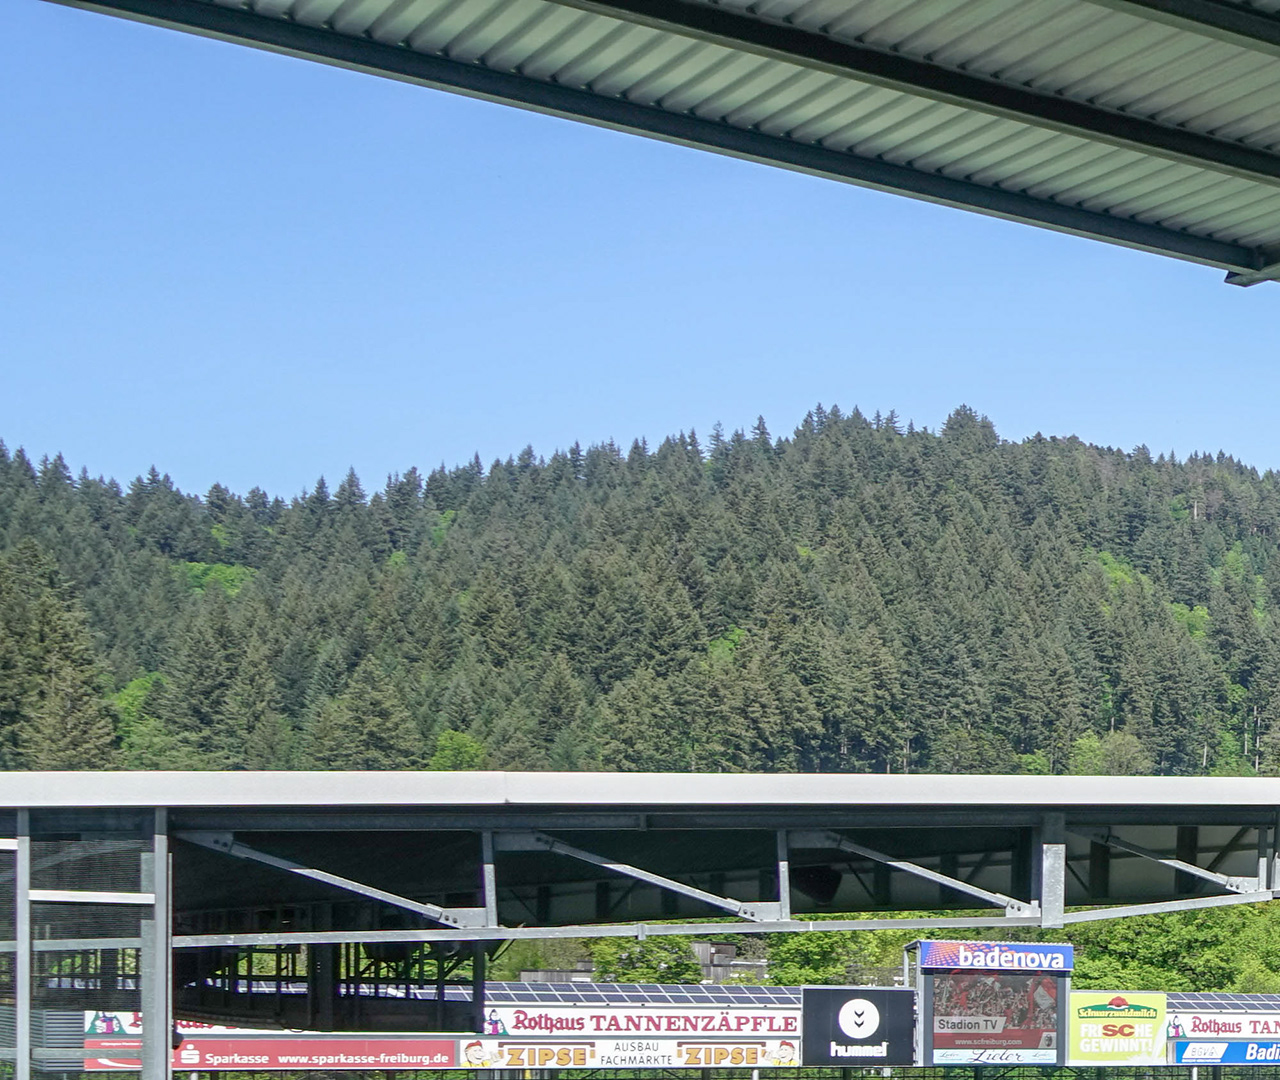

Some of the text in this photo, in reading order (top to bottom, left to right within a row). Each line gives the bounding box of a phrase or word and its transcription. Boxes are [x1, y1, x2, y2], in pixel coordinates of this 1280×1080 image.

[959, 946, 1065, 968] badenova
[511, 1010, 798, 1033] Rothaus TANNENZÄPFLE
[938, 1018, 998, 1030] Stadion TV
[1190, 1016, 1242, 1036] Rothaus
[1080, 1024, 1152, 1038] FRISCHE
[614, 1042, 660, 1052] AUSBAU
[830, 1041, 888, 1058] hummel
[954, 1038, 1023, 1047] www.scfreiburg.com
[1080, 1038, 1153, 1053] GEWINNT!
[206, 1051, 450, 1067] Sparkasse www.sparkasse-freiburg.de
[506, 1047, 587, 1067] ZIPSE
[600, 1051, 672, 1066] FACHMÄRKTE
[685, 1047, 758, 1065] ZIPSE
